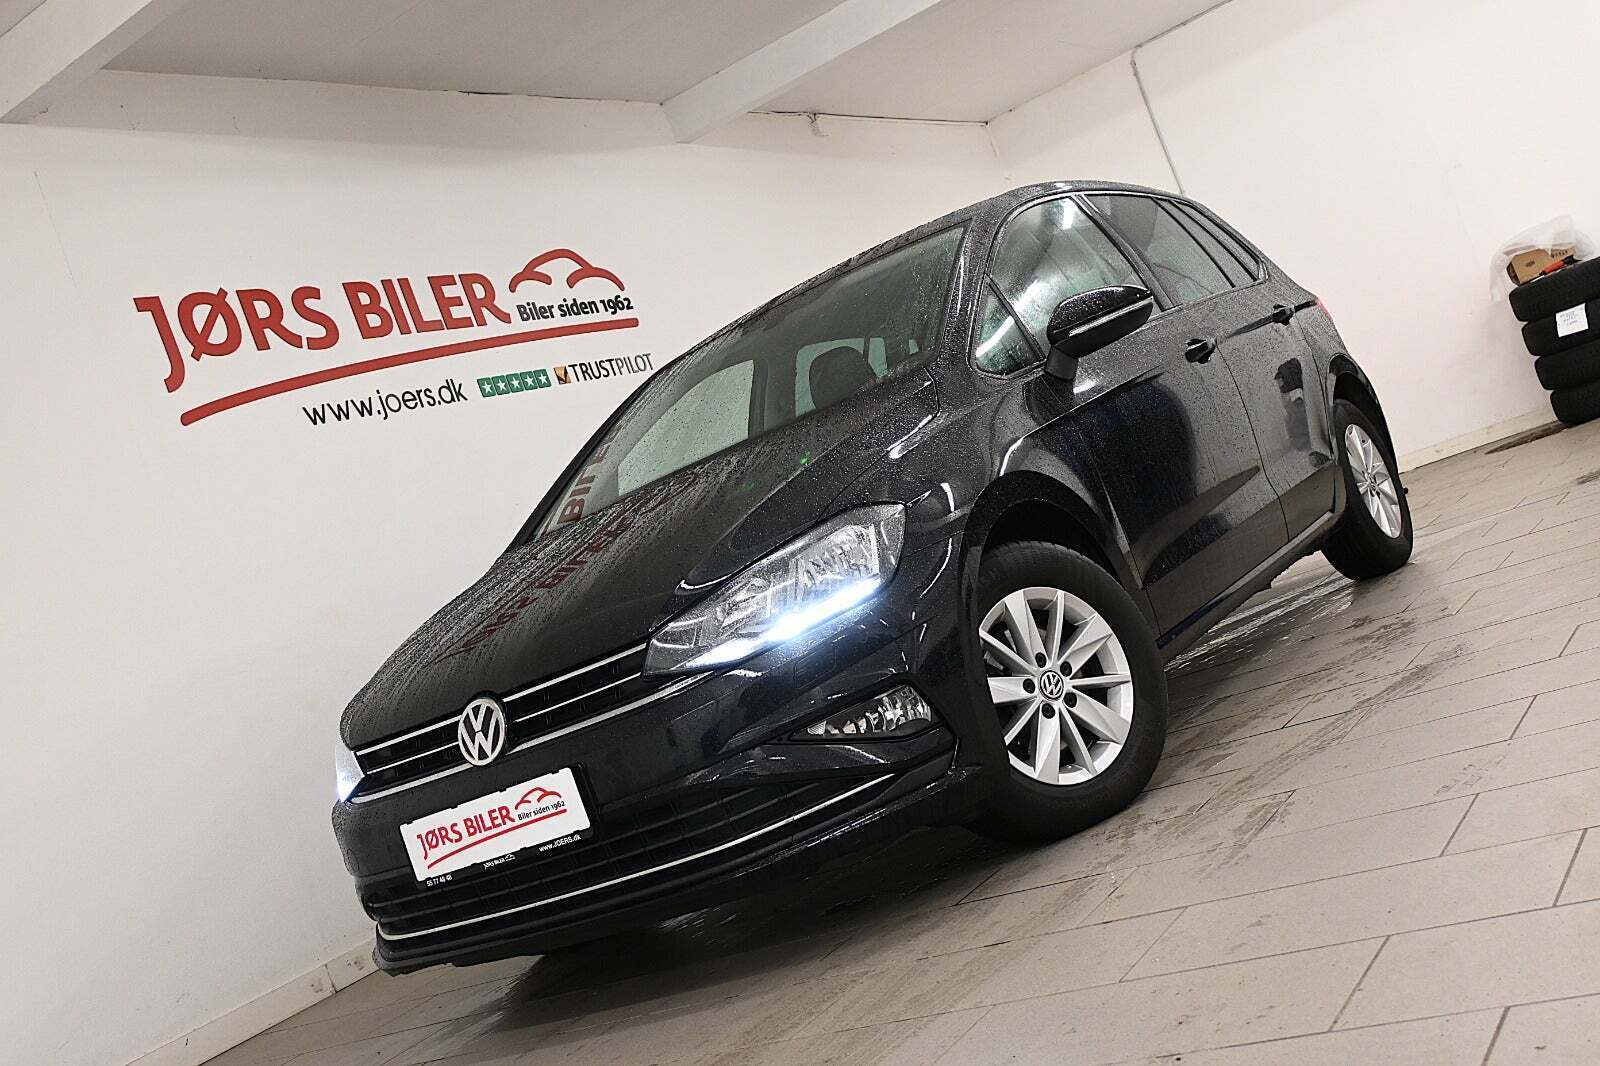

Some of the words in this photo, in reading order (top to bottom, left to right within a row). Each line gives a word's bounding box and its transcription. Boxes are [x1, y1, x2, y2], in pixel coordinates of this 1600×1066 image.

[516, 302, 555, 322] Biler
[557, 298, 600, 318] siden
[600, 295, 634, 316] 1962
[133, 286, 340, 393] JØRS
[341, 272, 512, 340] BILER
[568, 353, 654, 382] TRUSTPILOT
[302, 377, 467, 426] www.joers.dk
[518, 811, 533, 821] Biler
[533, 806, 551, 816] siden
[551, 801, 566, 811] 1962
[416, 822, 463, 860] JØRS
[463, 805, 515, 837] BILER
